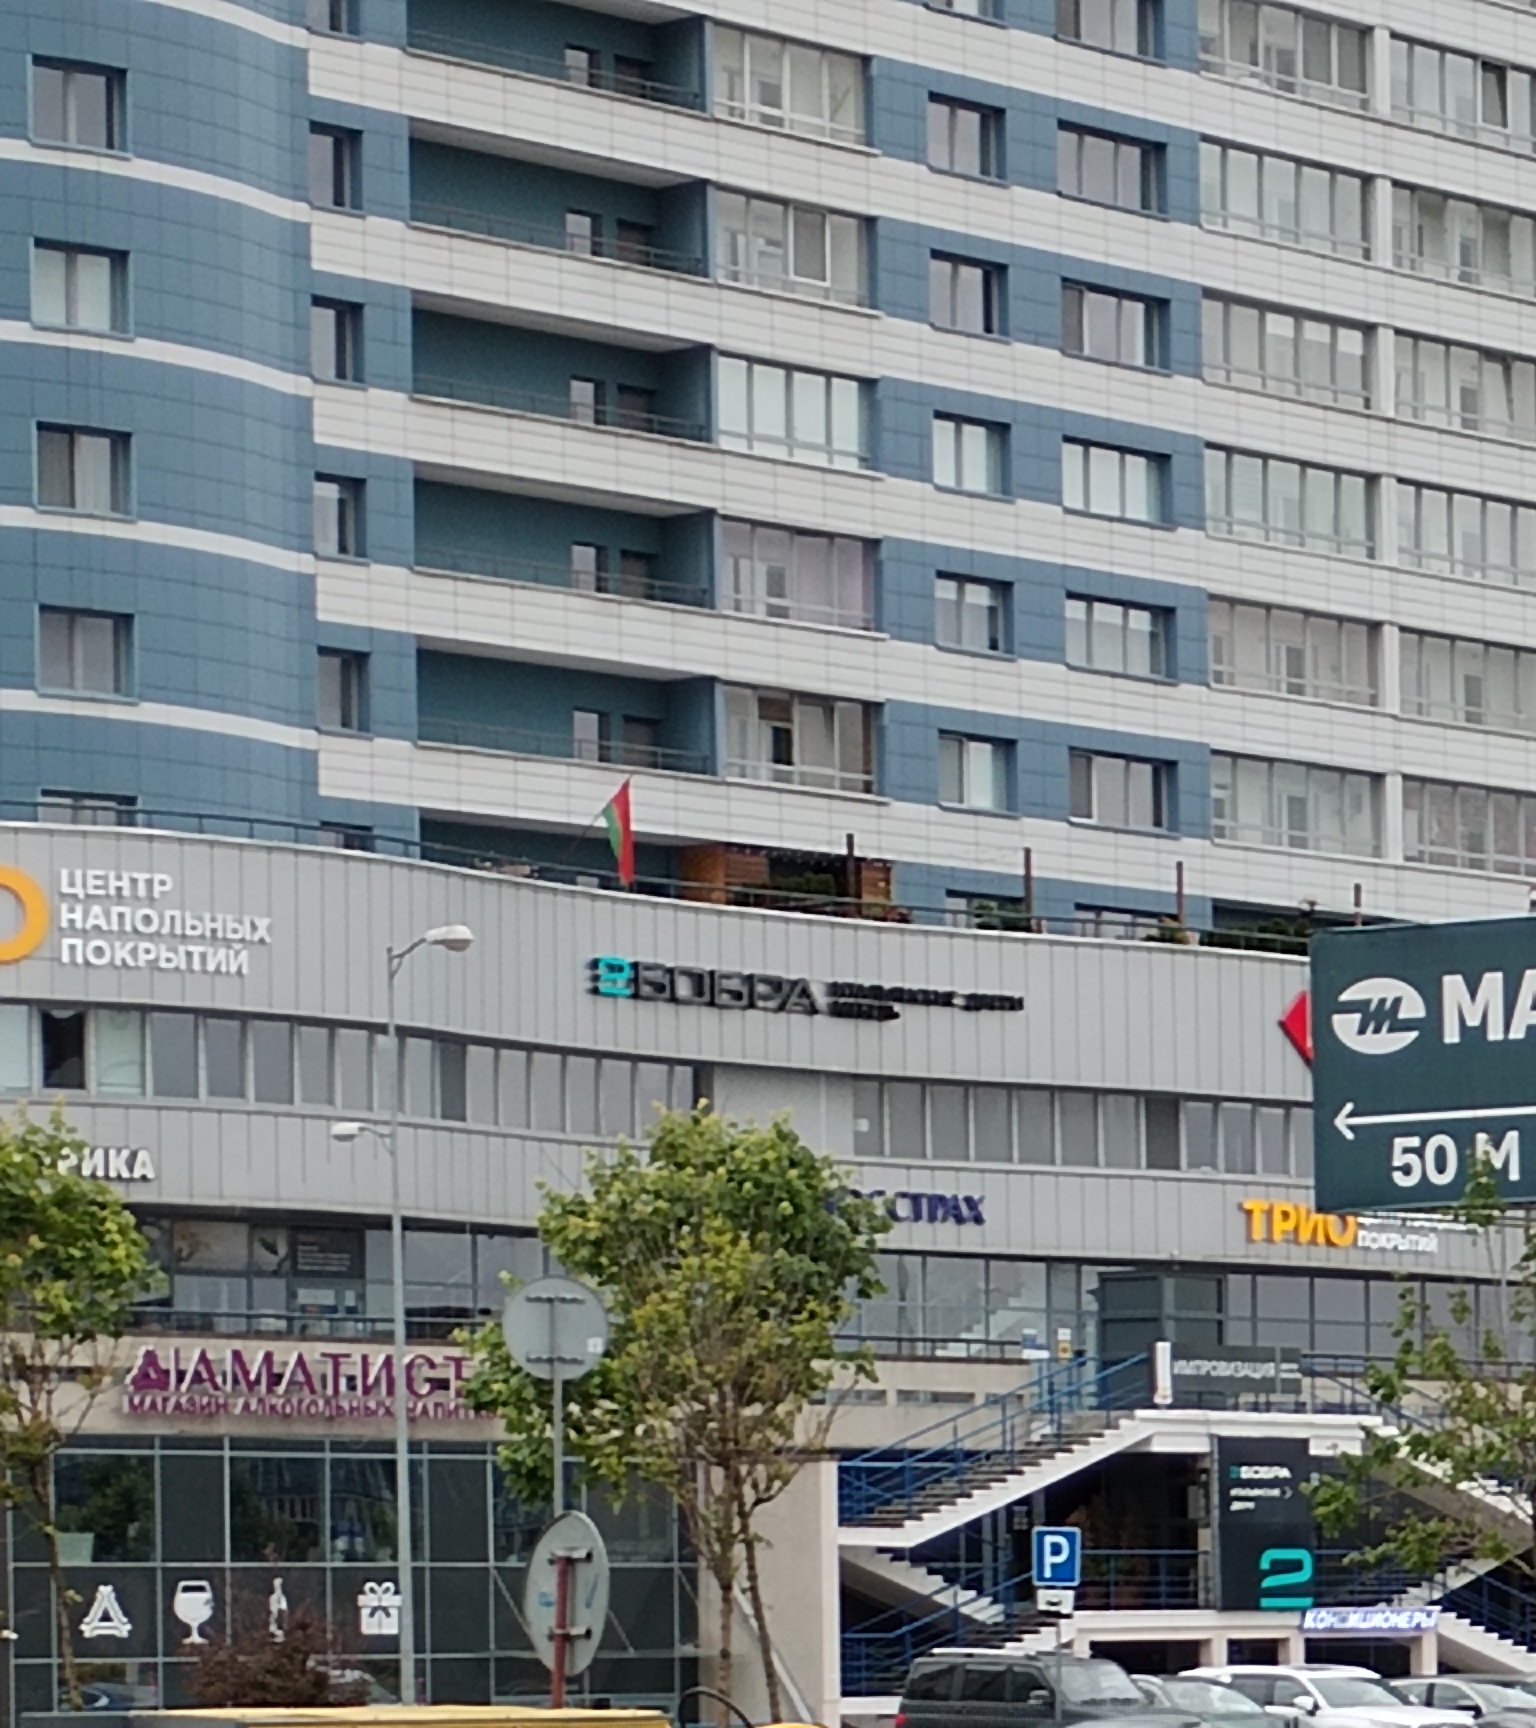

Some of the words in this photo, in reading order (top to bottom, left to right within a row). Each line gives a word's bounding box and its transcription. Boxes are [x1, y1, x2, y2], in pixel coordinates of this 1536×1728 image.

[60, 868, 174, 899] ЦЕНТР
[60, 903, 272, 944] НАПОЛЬНЫХ
[61, 937, 250, 975] ПОКРЫТИЙ
[1391, 1134, 1458, 1187] 50
[1242, 1200, 1357, 1248] ТРИО
[122, 1393, 228, 1415] МАГАЗИН
[232, 1396, 395, 1418] АЛКОГОЛЬНЫХ
[1043, 1534, 1070, 1579] P
